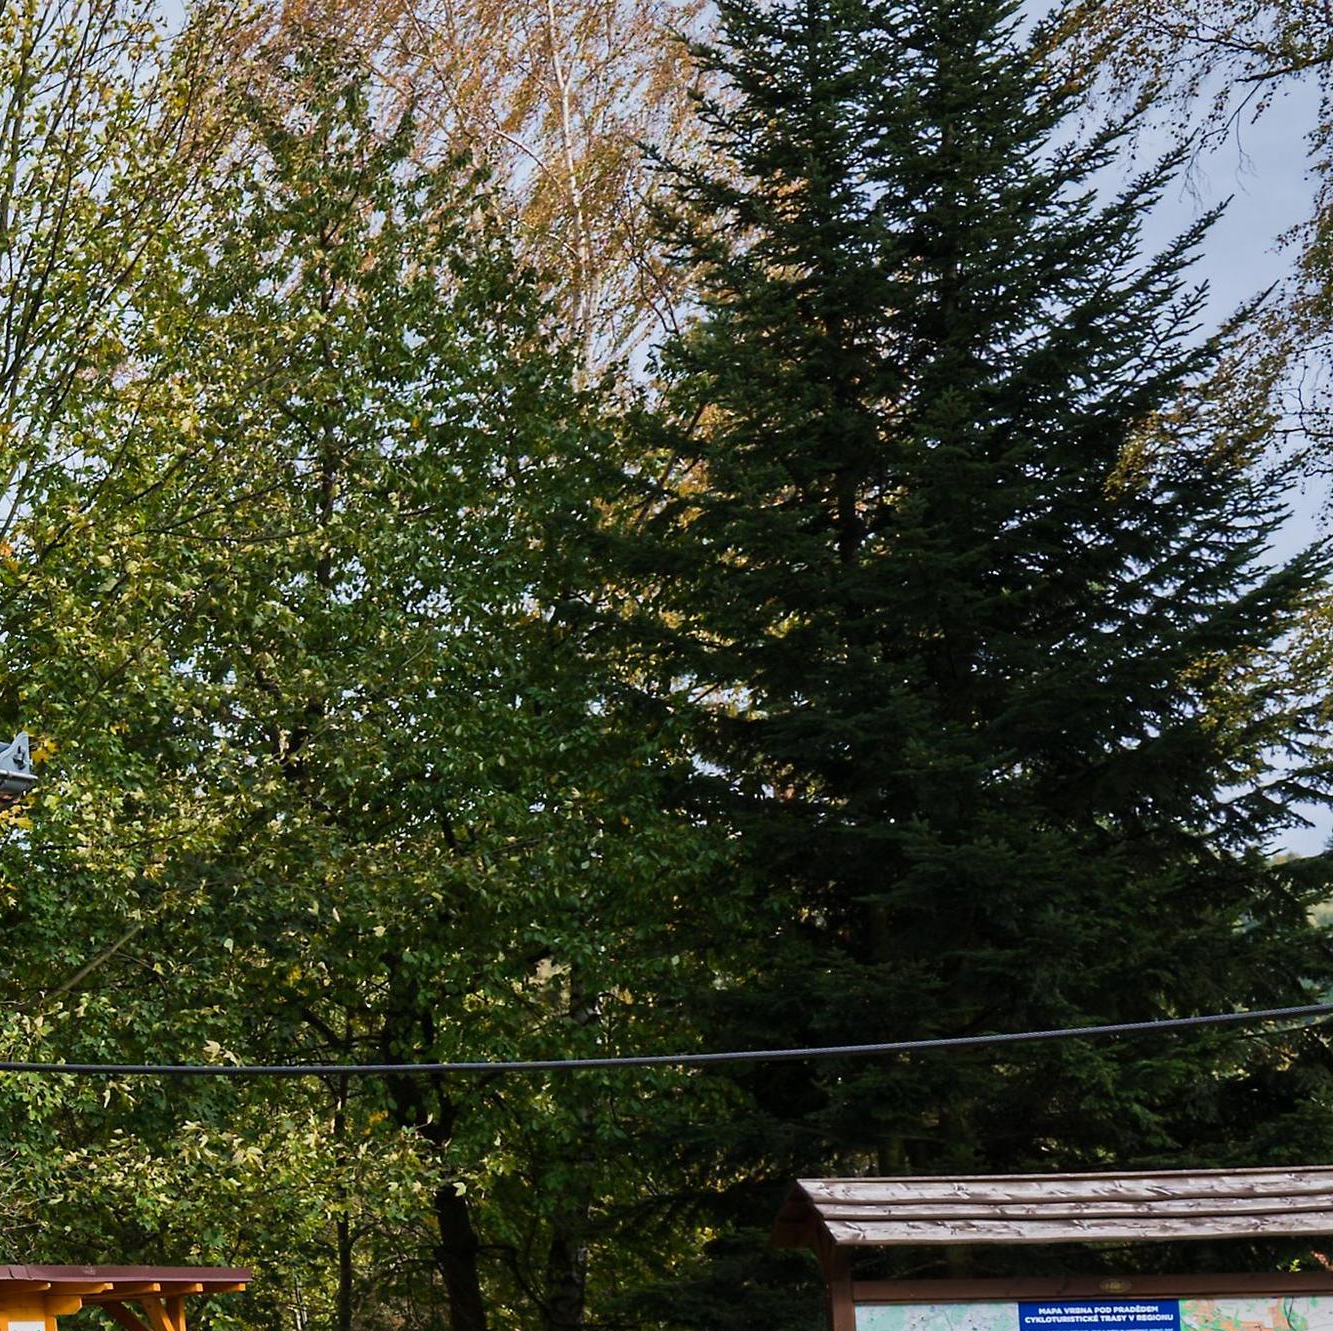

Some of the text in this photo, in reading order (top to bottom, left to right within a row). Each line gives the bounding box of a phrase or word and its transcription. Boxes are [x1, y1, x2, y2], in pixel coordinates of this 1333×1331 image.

[1038, 1304, 1159, 1315] MAPA VRBNA POD PRADĚDEM
[1024, 1314, 1099, 1324] CYKLOTURISTICKÉ
[1100, 1314, 1127, 1323] TRASY
[1136, 1314, 1174, 1322] REGIONU
